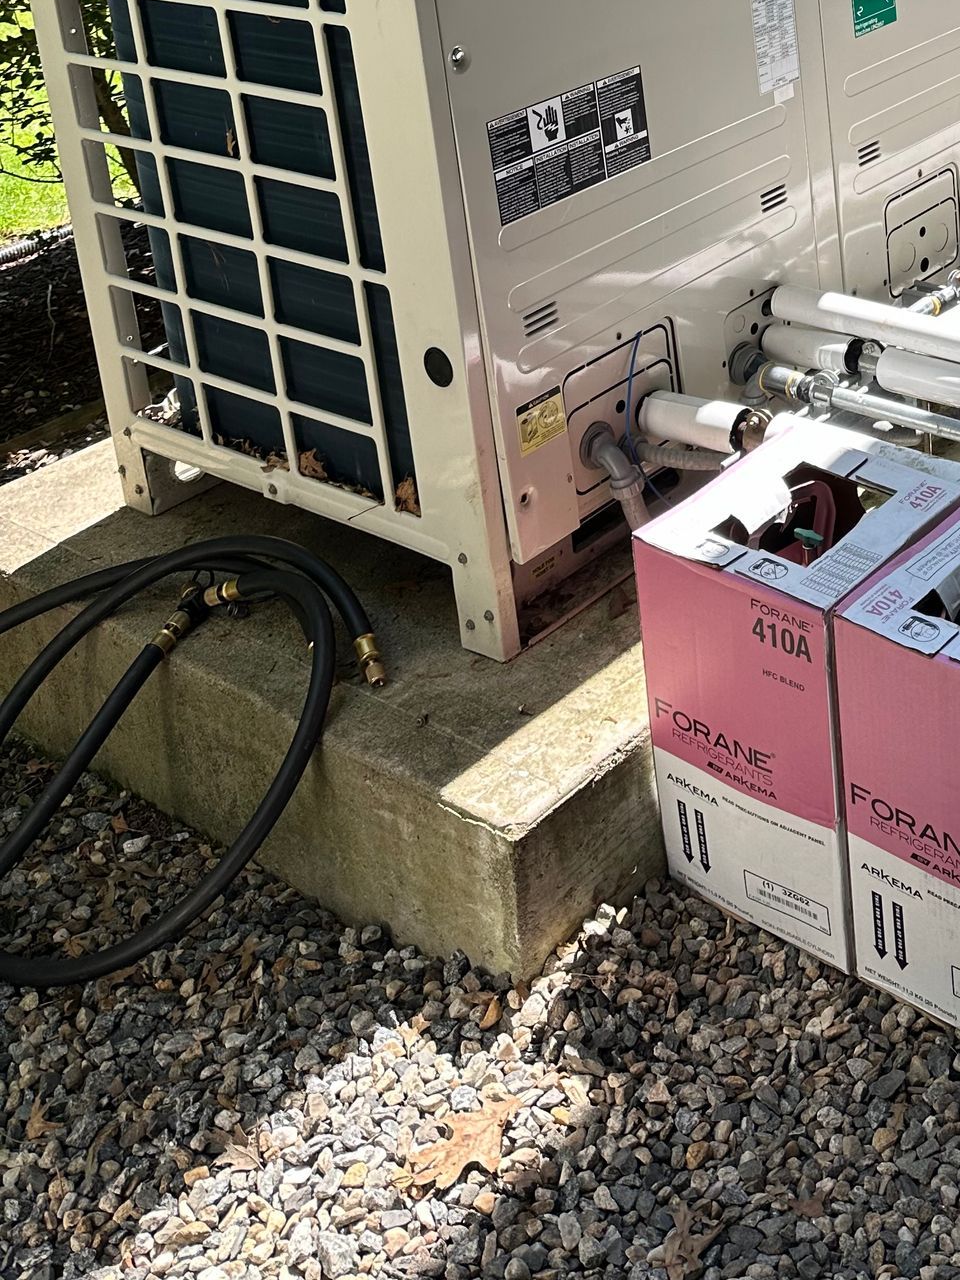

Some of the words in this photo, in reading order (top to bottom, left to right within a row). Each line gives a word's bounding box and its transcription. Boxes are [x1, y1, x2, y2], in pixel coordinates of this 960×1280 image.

[857, 6, 864, 17] 2
[570, 86, 591, 98] WARNING
[568, 133, 599, 150] INSTALLATION
[619, 135, 639, 147] WARNING
[536, 146, 568, 163] INSTALLATION
[506, 164, 523, 175] NOTICE
[909, 485, 942, 509] 410A
[865, 589, 903, 617] 410A
[752, 617, 812, 664] 410A
[762, 668, 778, 680] HFC
[780, 675, 805, 692] BLEND
[672, 728, 774, 786] REFRIGERANTS
[666, 773, 719, 807] ARKEMA
[724, 770, 778, 800] ARKEMA
[735, 802, 770, 824] PRECAUTIONS
[779, 822, 807, 839] ADJACENT
[808, 836, 826, 846] PANEL
[762, 880, 774, 892] (1)
[782, 888, 810, 906] 3ZG62
[860, 862, 924, 901] ARKEMA
[927, 890, 942, 901] READ
